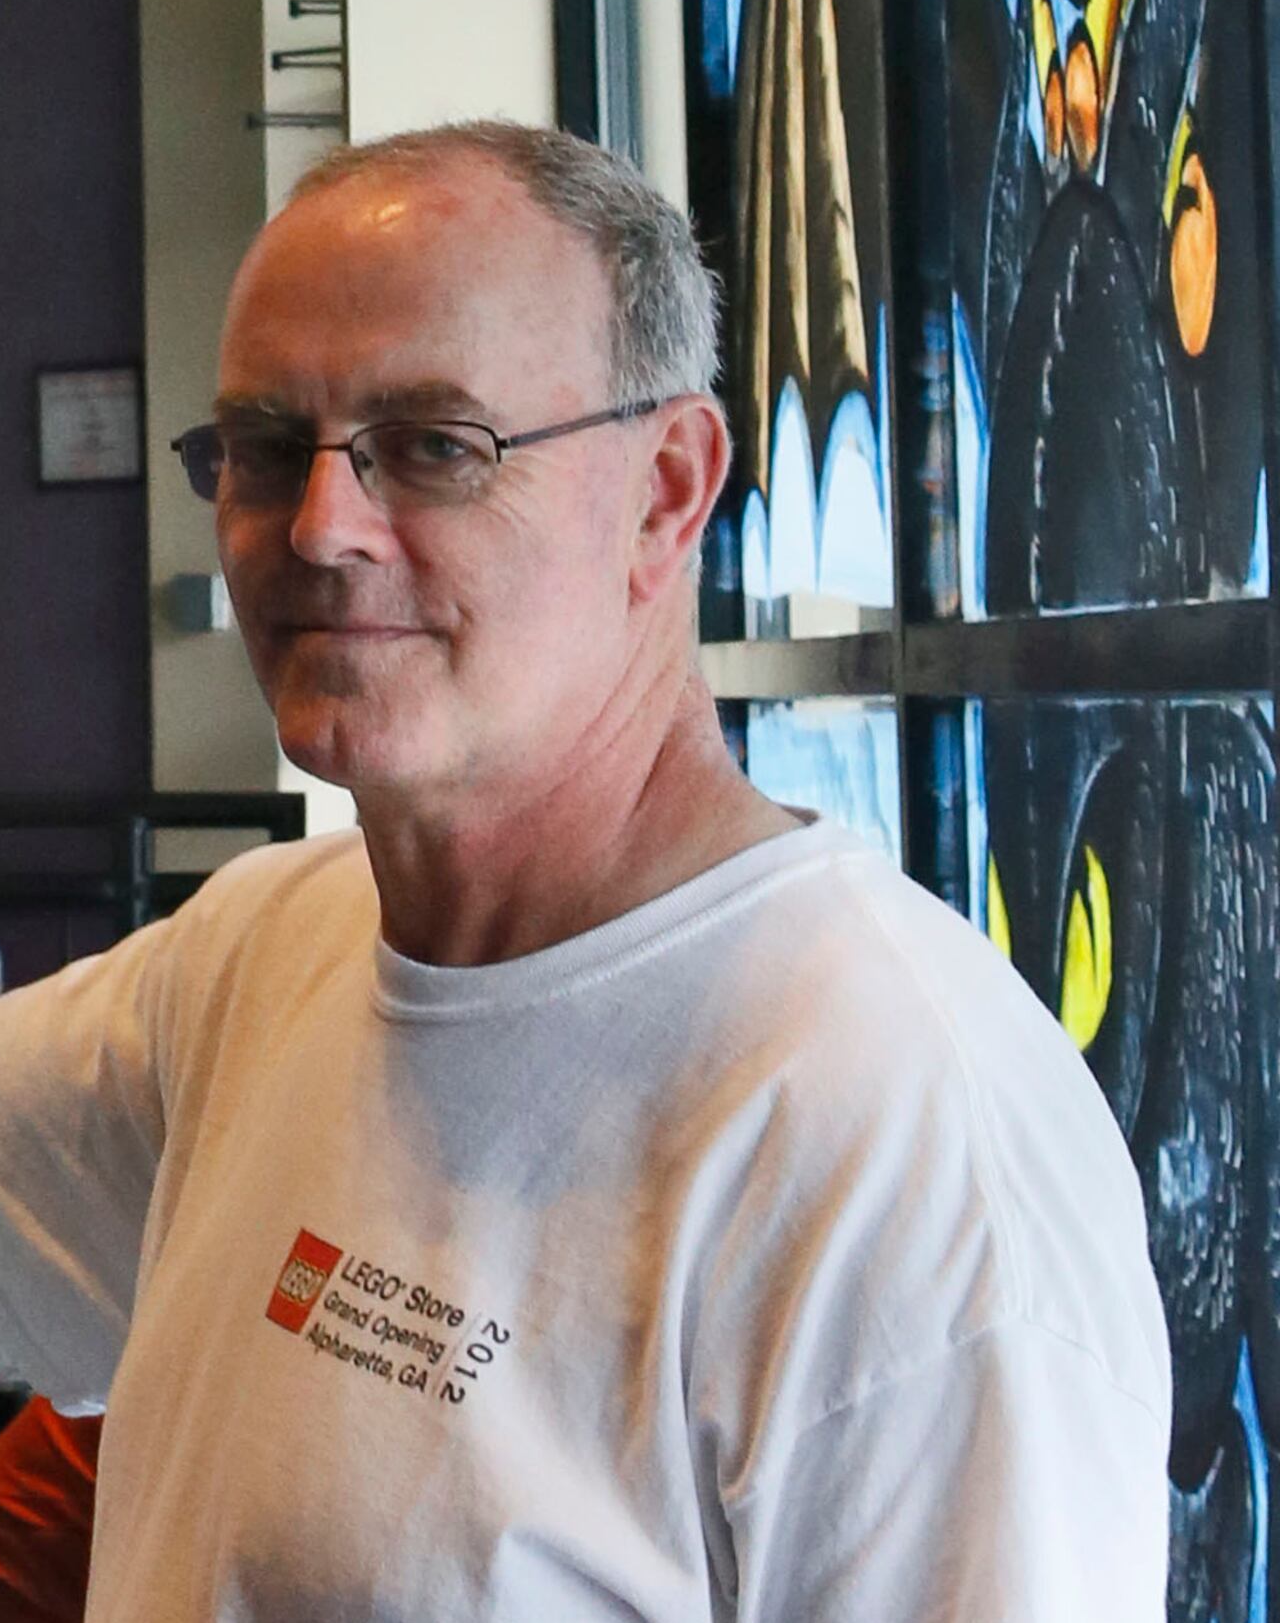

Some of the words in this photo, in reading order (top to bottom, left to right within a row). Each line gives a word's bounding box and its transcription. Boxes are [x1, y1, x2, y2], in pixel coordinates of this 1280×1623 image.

[323, 1290, 374, 1330] Grand
[371, 1316, 446, 1366] Opening
[405, 1286, 465, 1327] Store
[305, 1321, 394, 1384] Alpharetta,
[398, 1364, 428, 1393] GA
[440, 1319, 510, 1404] 2012
